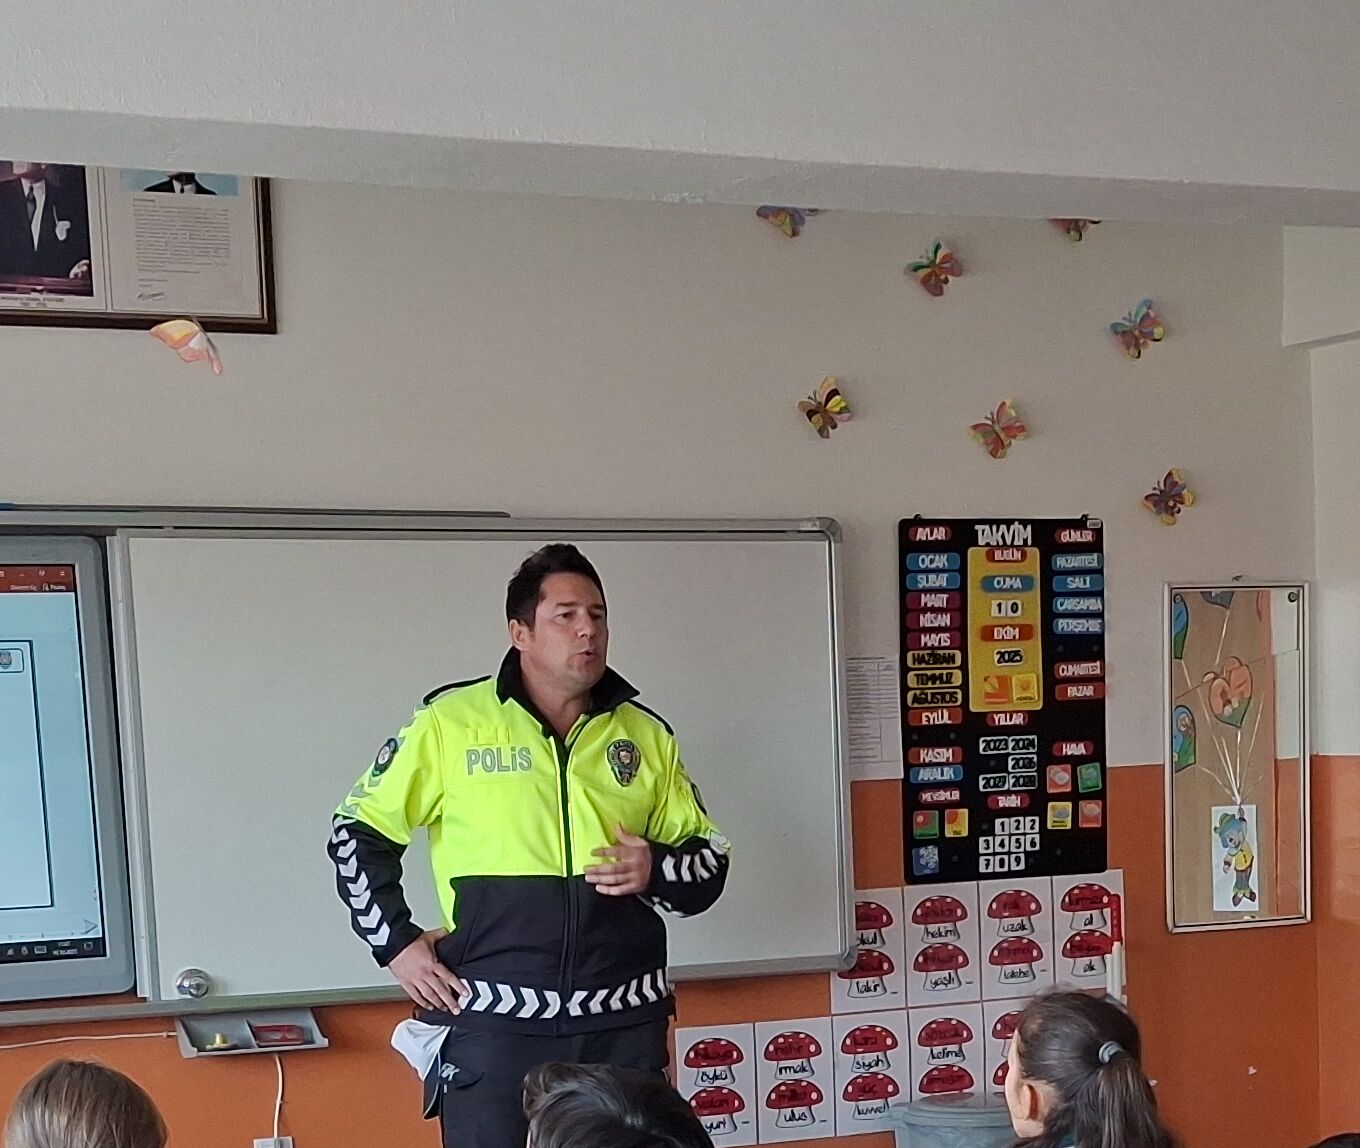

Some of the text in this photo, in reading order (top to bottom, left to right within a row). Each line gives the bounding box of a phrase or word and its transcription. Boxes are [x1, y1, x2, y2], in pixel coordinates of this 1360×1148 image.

[975, 521, 1031, 546] TAKVİM
[918, 555, 948, 568] OCAK
[917, 574, 948, 588] ŞUBAT
[993, 577, 1022, 589] CUMA
[996, 650, 1023, 663] 2025
[1067, 685, 1094, 697] PAZAR
